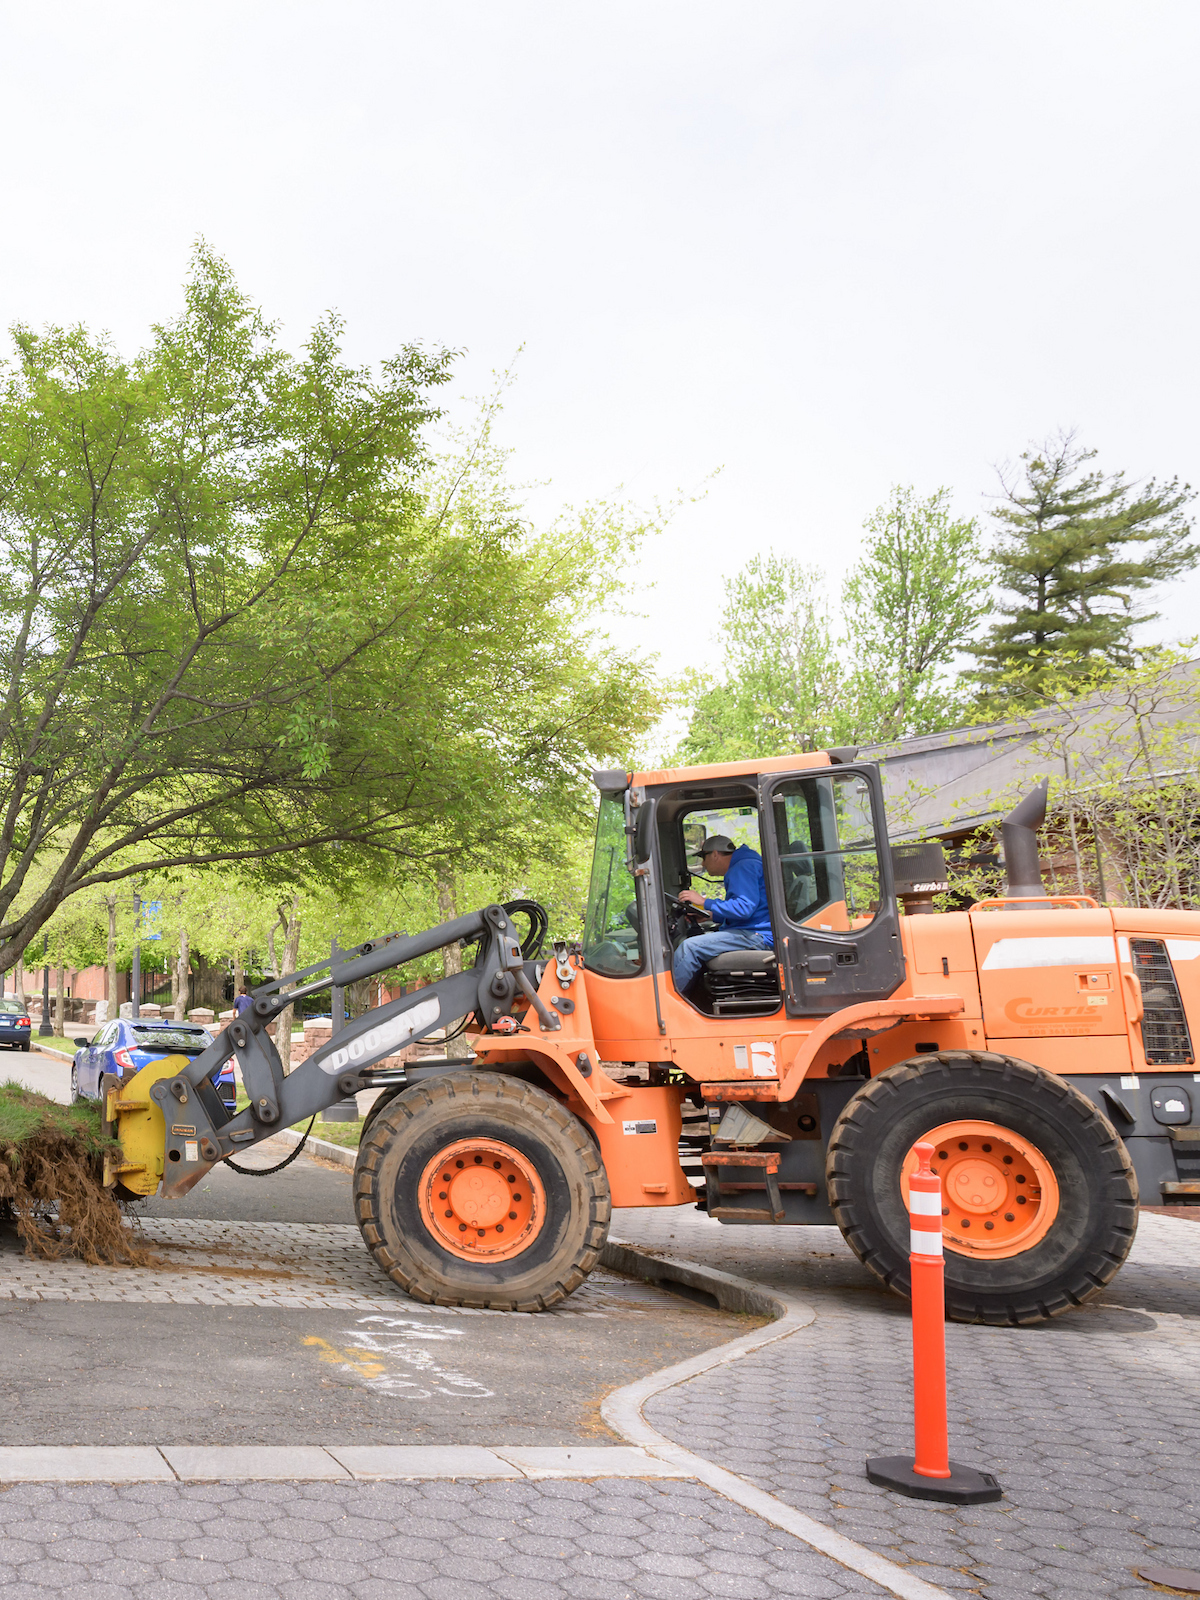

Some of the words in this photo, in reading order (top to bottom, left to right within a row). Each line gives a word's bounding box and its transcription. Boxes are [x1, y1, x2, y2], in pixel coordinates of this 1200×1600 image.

[913, 881, 941, 892] turbo
[1003, 997, 1101, 1024] CURTIS
[331, 1000, 433, 1071] DOOSAN
